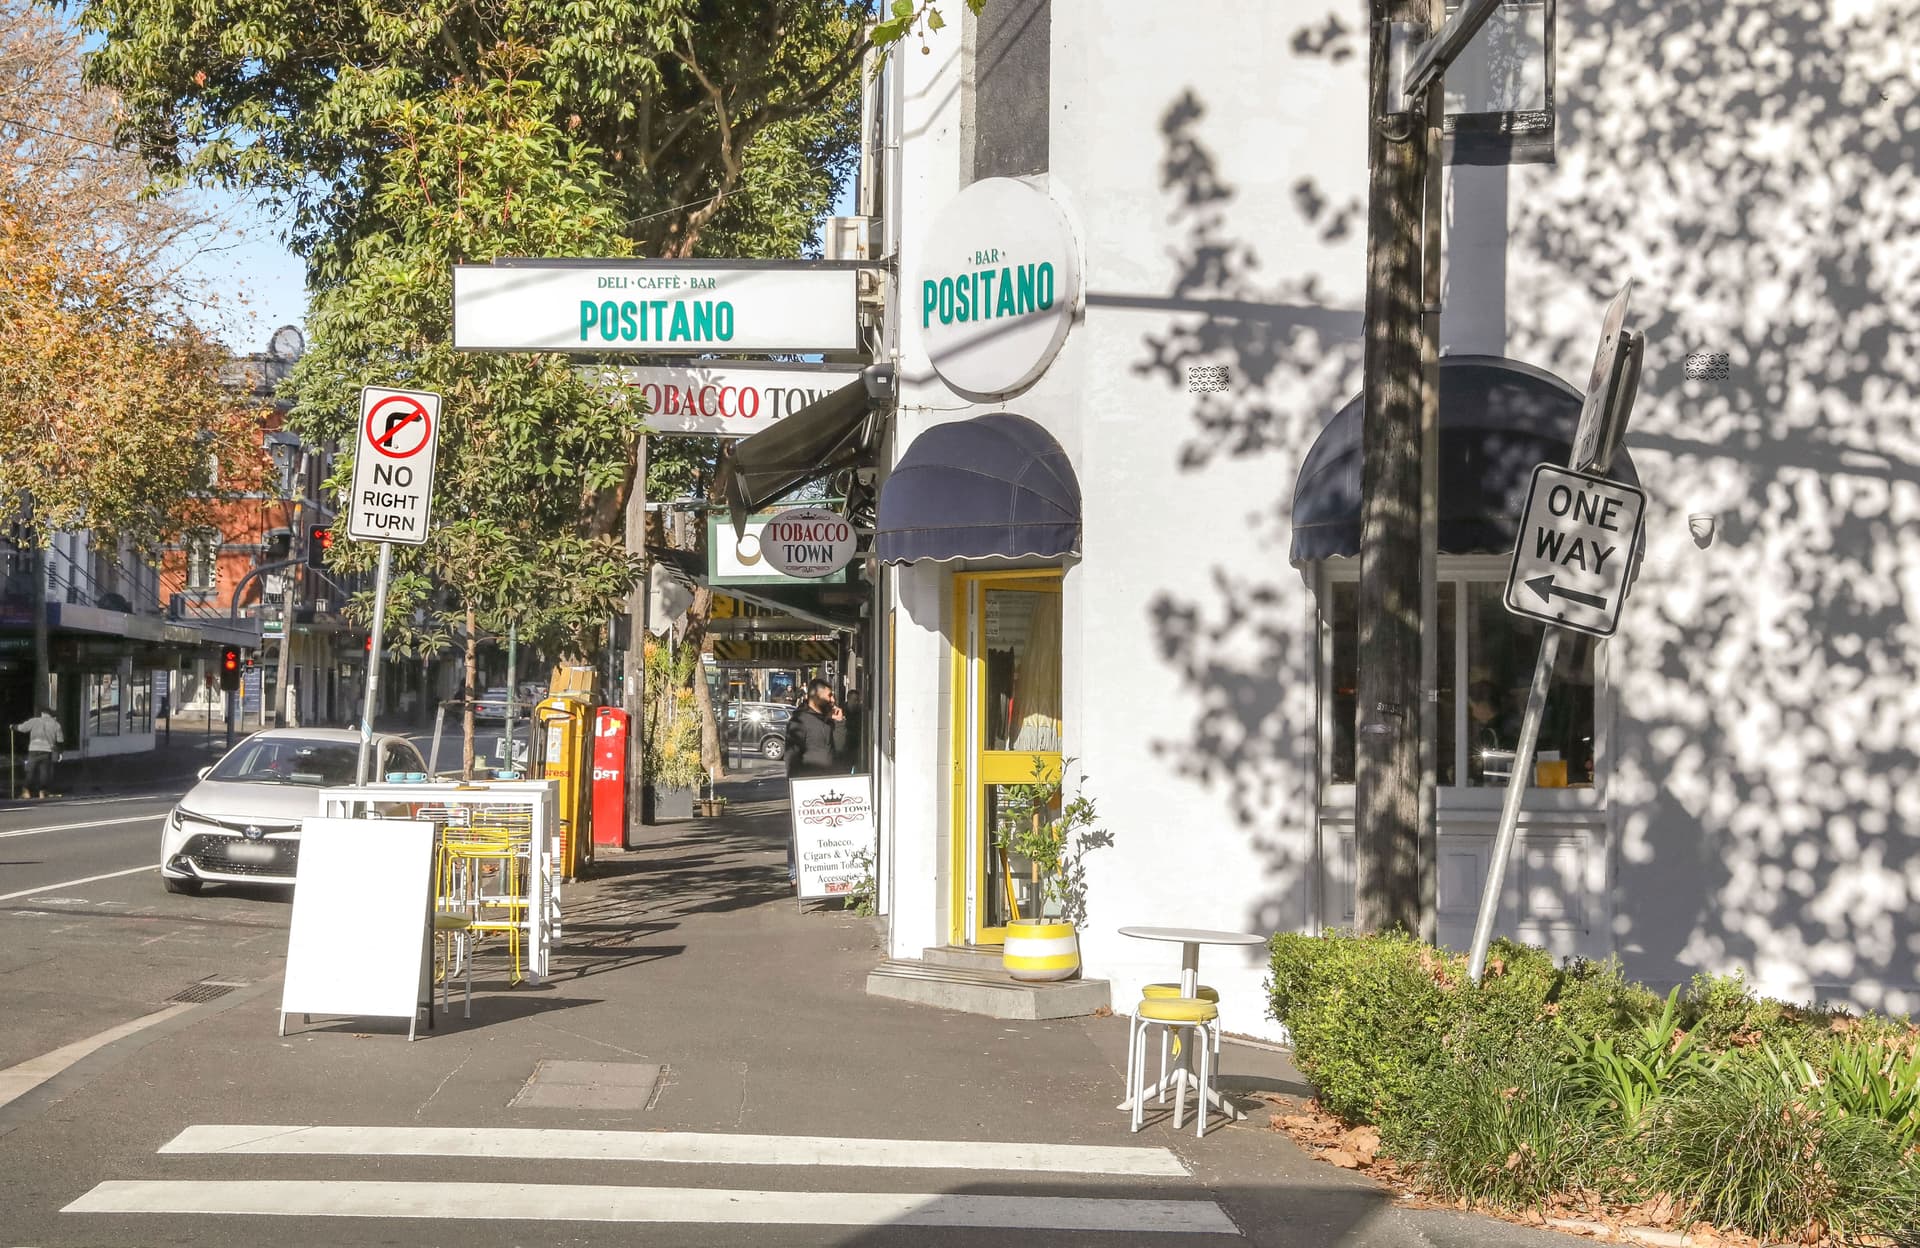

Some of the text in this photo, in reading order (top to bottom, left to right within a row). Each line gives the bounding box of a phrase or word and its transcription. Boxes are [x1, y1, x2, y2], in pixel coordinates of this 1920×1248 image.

[975, 248, 999, 265] BAR
[598, 275, 716, 289] DELI CAFFÈ BAR
[923, 261, 1054, 328] POSITANO
[580, 300, 734, 342] POSITANO
[626, 383, 834, 418] OBACCO TO
[374, 463, 413, 487] NO
[363, 490, 419, 510] RIGHT
[1548, 484, 1624, 532] ONE
[364, 512, 415, 531] TURN
[769, 523, 848, 542] TOBACCO
[782, 544, 833, 563] TOWN
[1536, 526, 1616, 575] WAY
[798, 804, 871, 817] TOBACCO TOWN
[803, 850, 831, 862] Cigars
[833, 850, 841, 859] &
[804, 862, 838, 873] Premium
